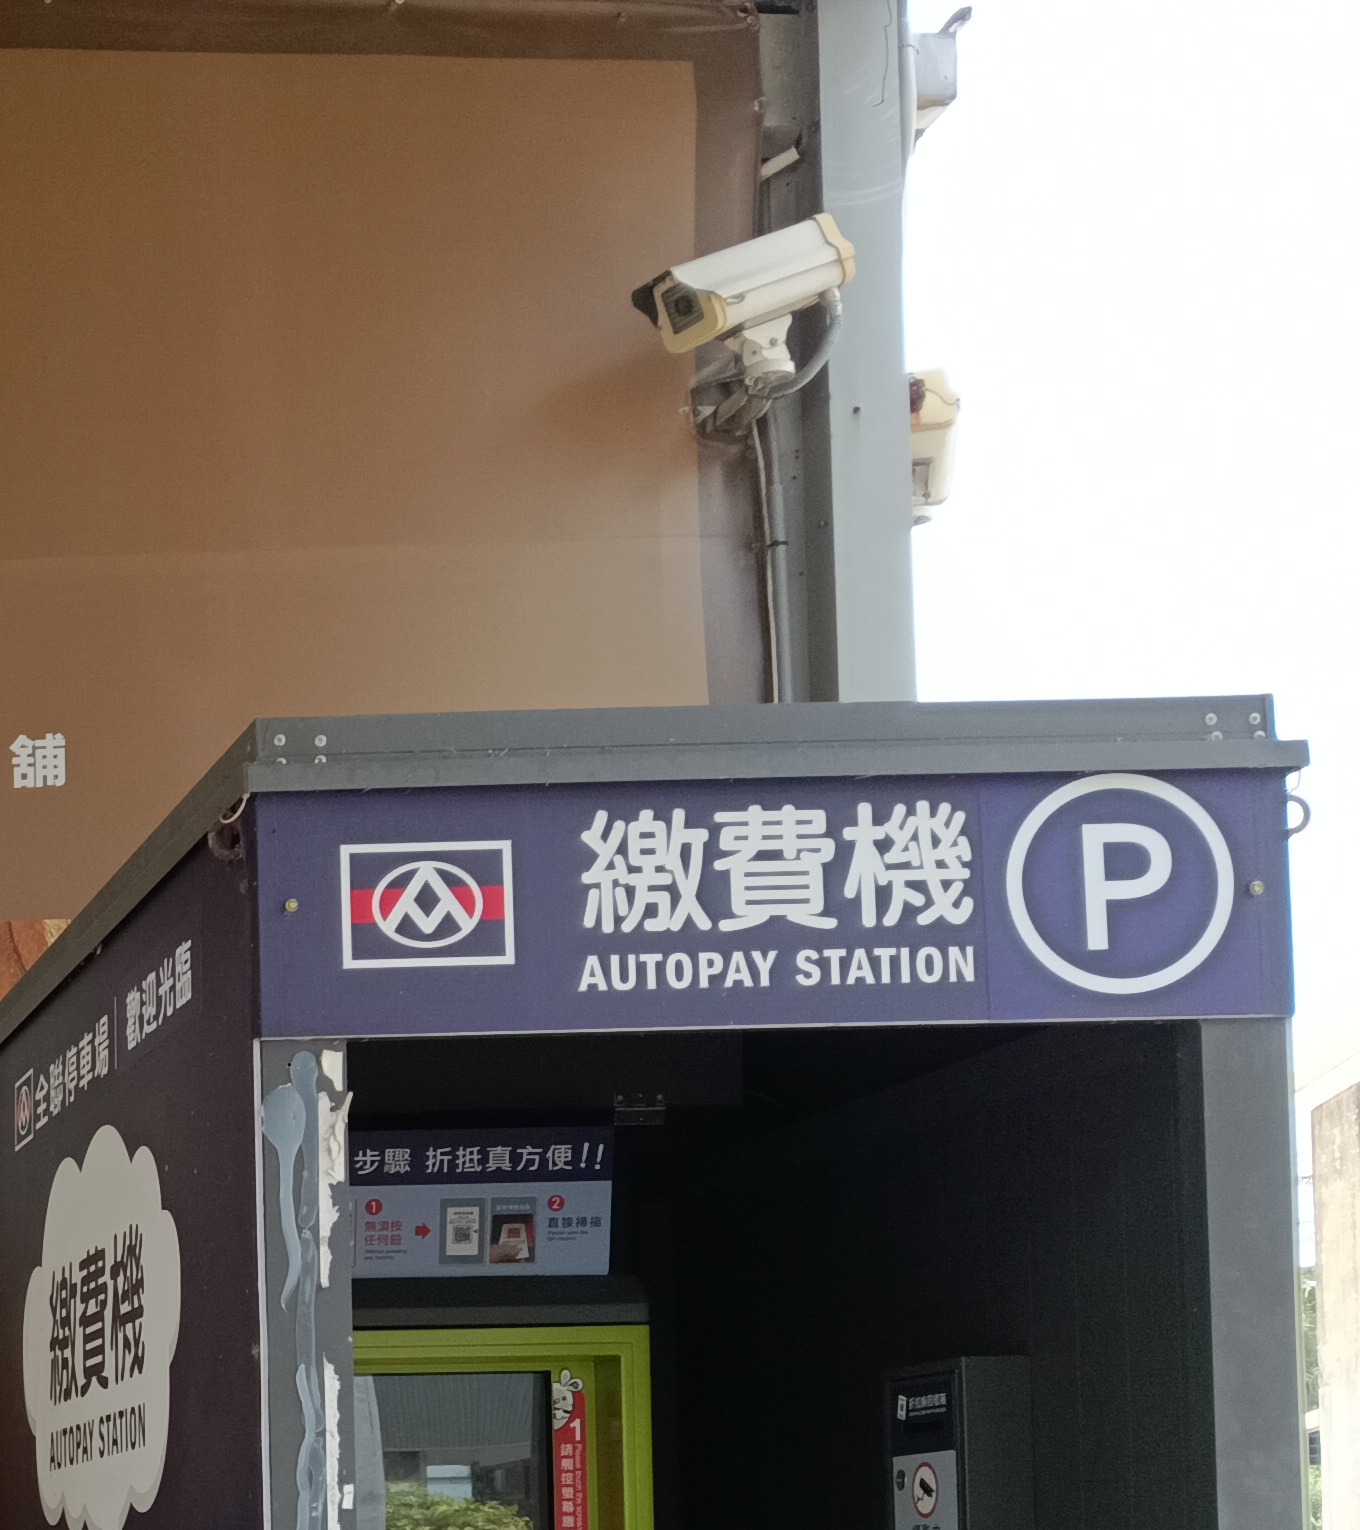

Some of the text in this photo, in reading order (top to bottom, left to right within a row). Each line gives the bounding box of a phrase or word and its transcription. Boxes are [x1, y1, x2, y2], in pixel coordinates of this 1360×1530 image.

[579, 800, 976, 934] 繳費機
[1080, 822, 1173, 951] P
[125, 940, 192, 1051] 歡迎光臨
[578, 946, 976, 992] AUTOPAY STATION
[34, 1014, 110, 1131] 全聯停車場
[49, 1223, 145, 1407] 繳費機
[49, 1403, 146, 1472] AUTOPAY STATION
